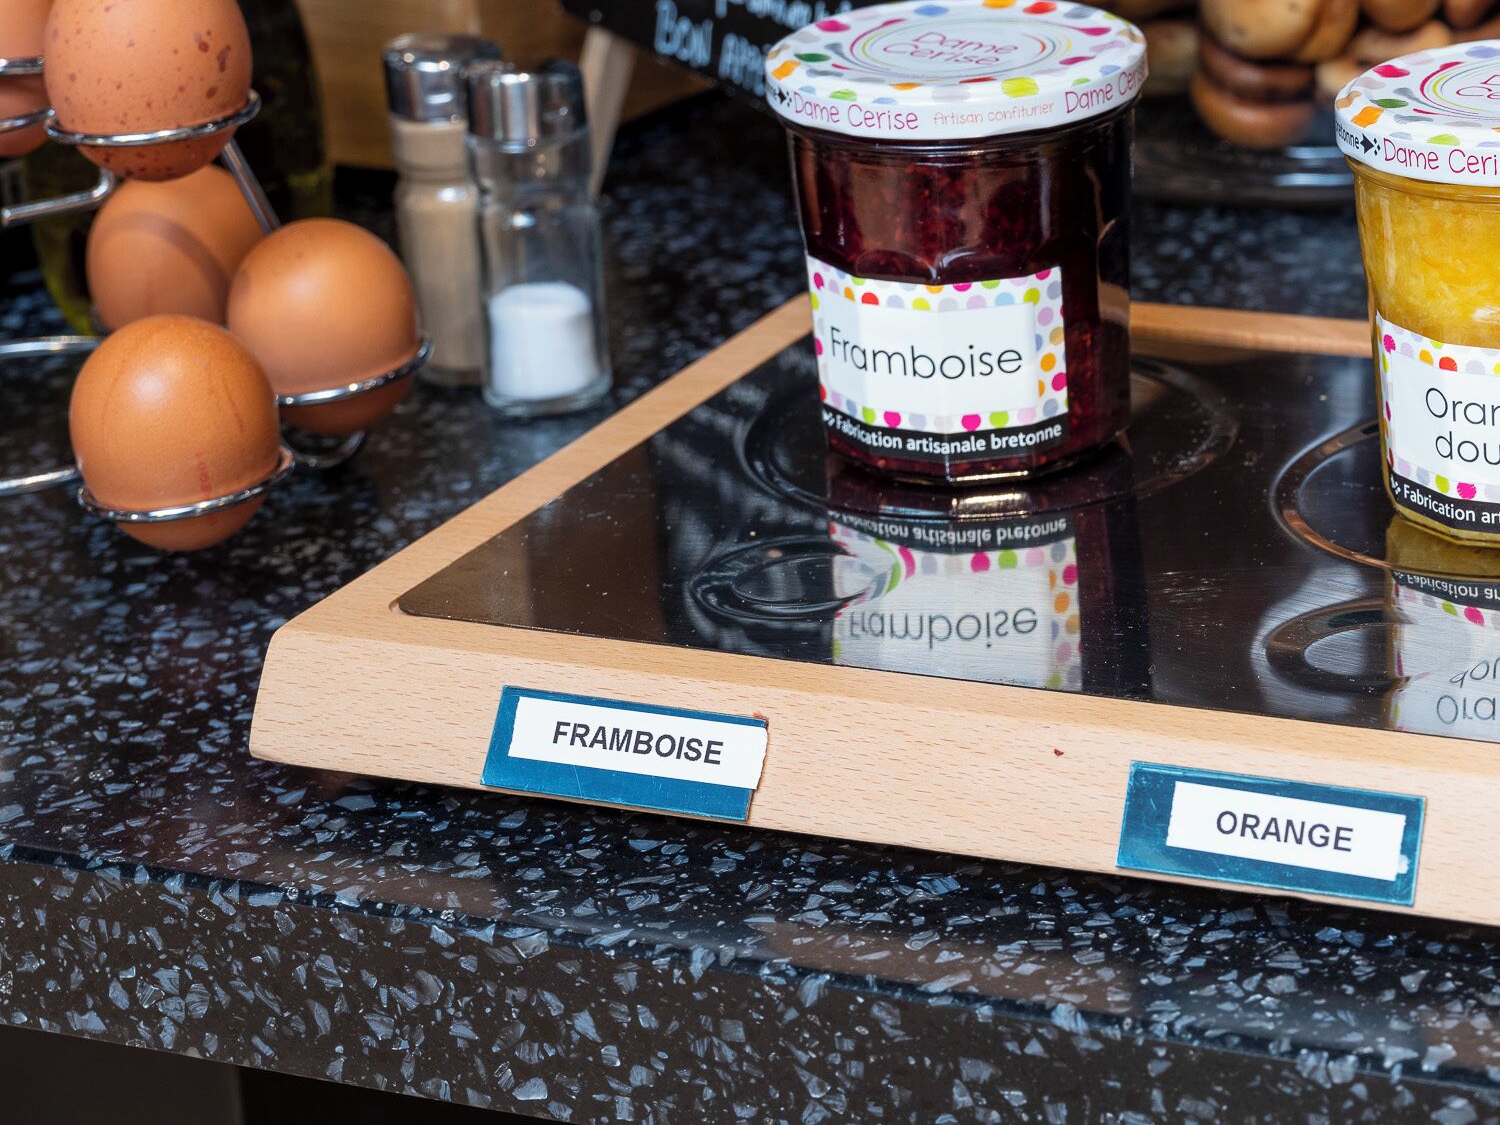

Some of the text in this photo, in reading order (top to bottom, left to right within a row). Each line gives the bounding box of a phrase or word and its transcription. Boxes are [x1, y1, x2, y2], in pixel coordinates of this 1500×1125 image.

[884, 42, 1000, 65] Cerise
[912, 32, 1018, 55] Dame
[794, 91, 840, 123] Dame
[847, 104, 919, 131] Cerise
[934, 111, 983, 125] Artisan
[987, 101, 1055, 123] confiturier
[1065, 83, 1113, 113] Dame
[1383, 137, 1440, 170] Dame
[830, 327, 1022, 379] Framboise
[834, 415, 1062, 455] Fabrication artisanale bretonne
[1404, 484, 1475, 522] Fabrication
[552, 721, 724, 765] FRAMBOISE
[1216, 810, 1354, 852] ORANGE
